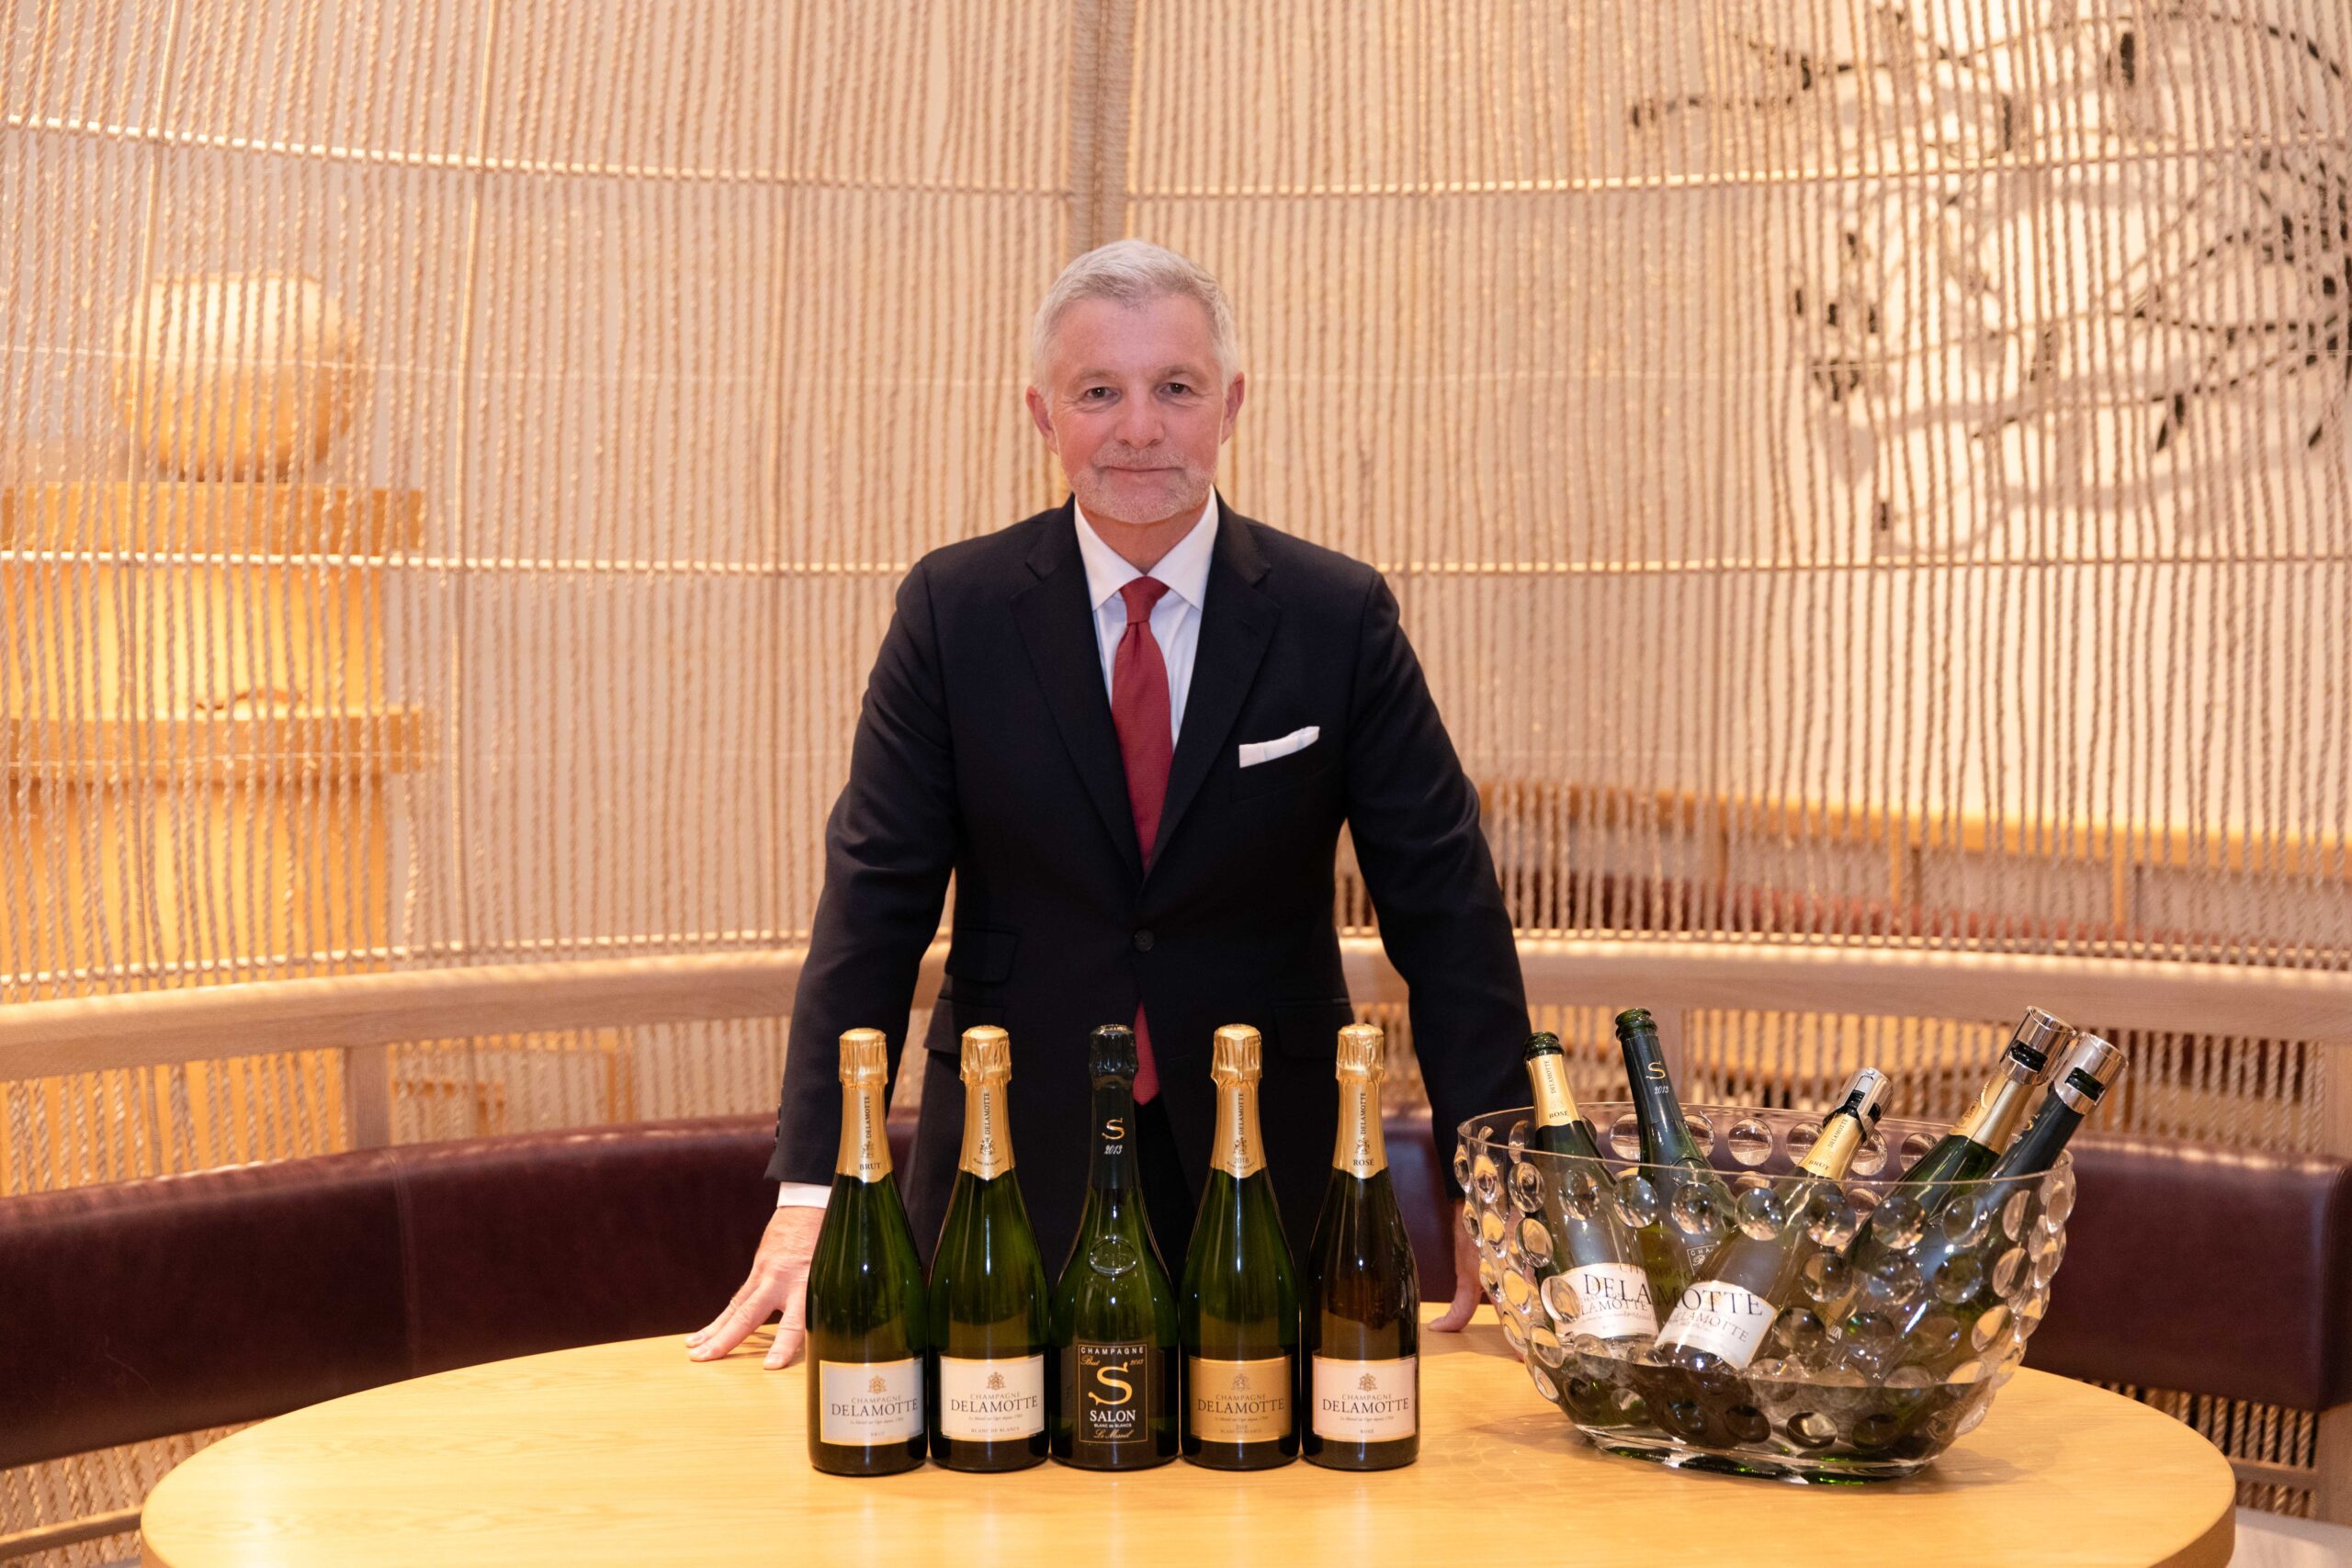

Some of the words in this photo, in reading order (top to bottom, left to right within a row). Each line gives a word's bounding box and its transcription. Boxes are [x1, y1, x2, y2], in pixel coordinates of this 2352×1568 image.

[1645, 1060, 1666, 1080] S
[1654, 1085, 1669, 1095] 2013
[1102, 1117, 1125, 1140] S
[1103, 1145, 1123, 1155] 2013
[859, 1162, 881, 1170] BRUT
[1583, 1273, 1763, 1316] DELAMOTTE
[1080, 1347, 1144, 1355] CHAMPAGNE
[1088, 1361, 1133, 1405] S
[851, 1394, 901, 1404] CHAMPAGNE
[951, 1395, 1038, 1413] DELAMOTTE
[969, 1392, 1020, 1401] CHAMPAGNE
[831, 1398, 918, 1416] DELAMOTTE
[1197, 1397, 1284, 1415] DELAMOTTE
[1323, 1397, 1409, 1414] DELAMOTTE
[1090, 1410, 1136, 1422] SALON
